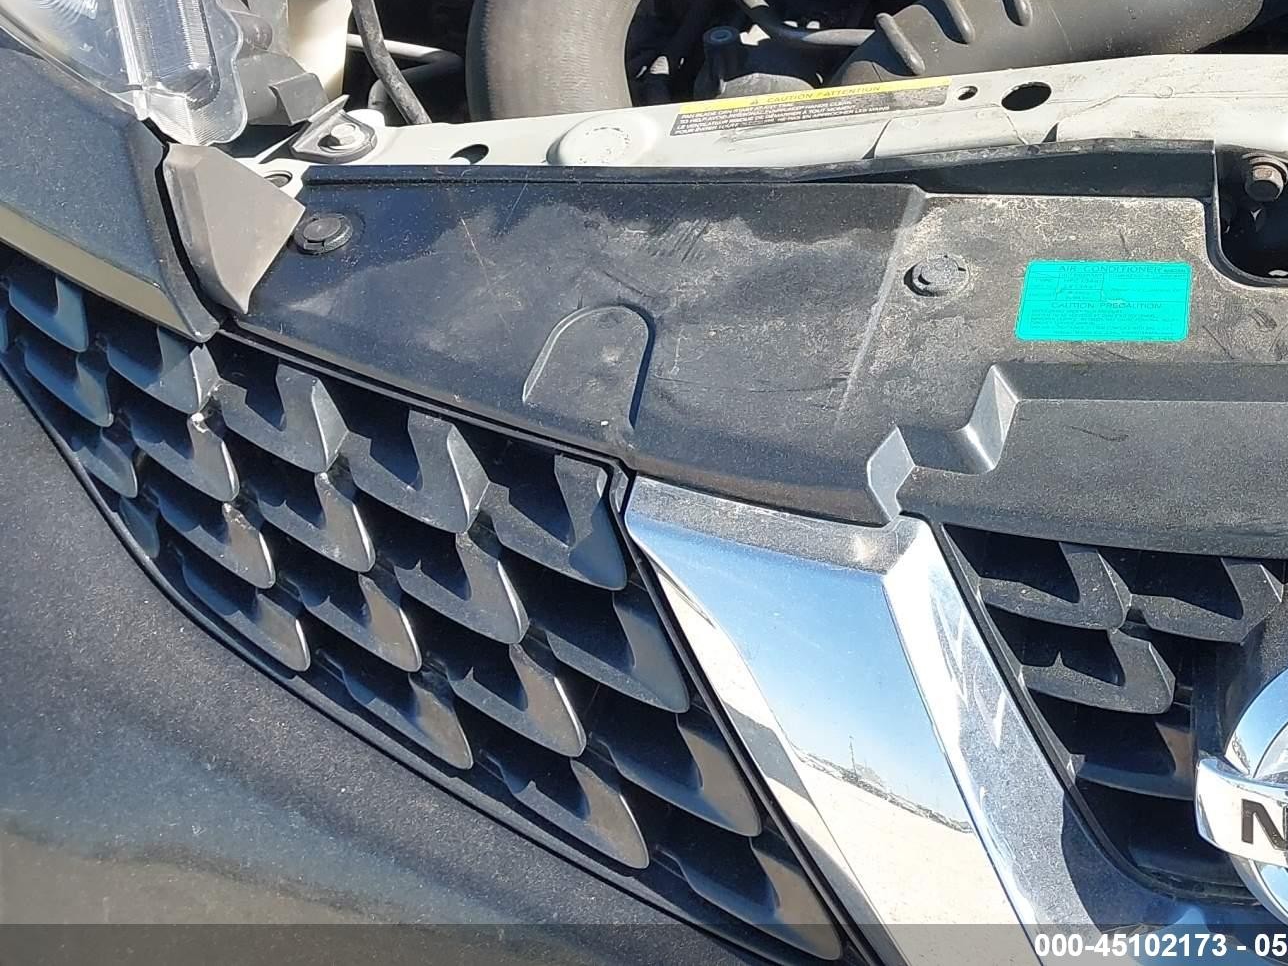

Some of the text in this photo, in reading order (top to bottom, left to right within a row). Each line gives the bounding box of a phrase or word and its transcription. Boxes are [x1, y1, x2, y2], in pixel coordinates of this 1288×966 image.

[767, 93, 813, 103] CAUTION
[823, 86, 881, 97] ATTENTION
[1059, 265, 1077, 273] AIR
[1083, 265, 1163, 274] CONDITIONER
[1051, 302, 1095, 310] CAUTION
